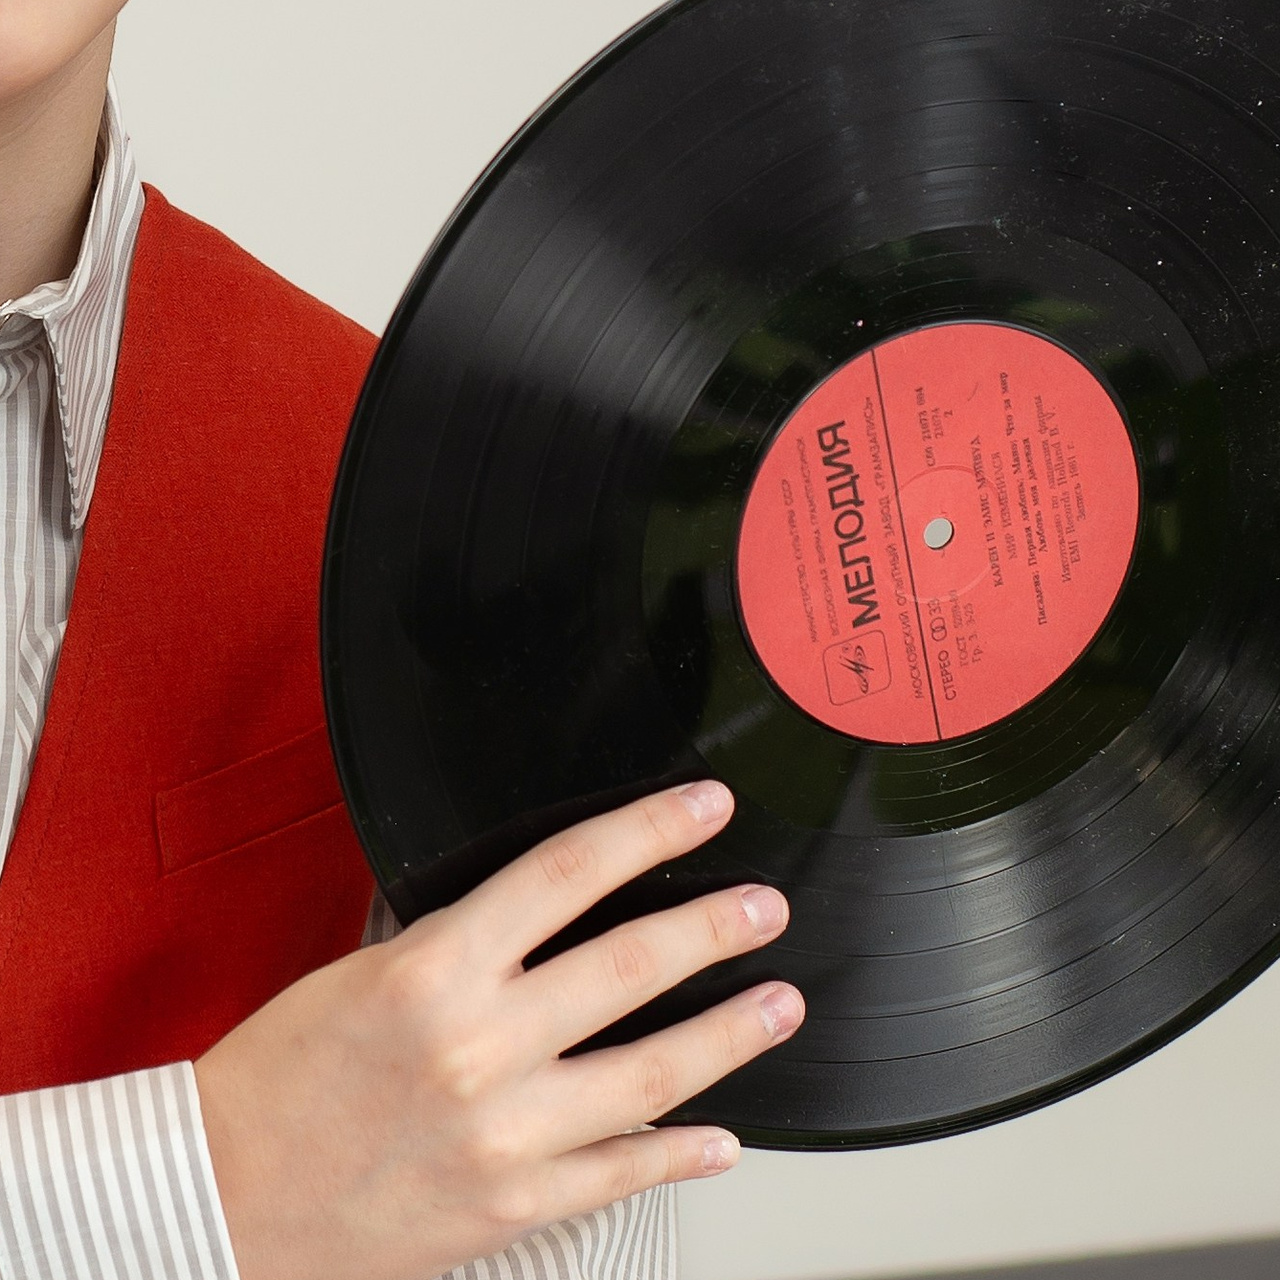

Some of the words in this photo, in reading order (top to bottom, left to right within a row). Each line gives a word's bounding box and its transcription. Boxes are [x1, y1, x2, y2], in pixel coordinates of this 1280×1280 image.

[942, 409, 954, 419] 2
[1005, 413, 1016, 438] Что
[1050, 440, 1069, 488] Holland
[979, 493, 993, 529] ЭЛИС
[990, 451, 1013, 529] ИЗМЕНИЛСЯ
[1029, 484, 1040, 507] моя
[1073, 481, 1087, 522] Запись
[815, 419, 882, 630] МЕЛОДИЯ
[877, 494, 896, 539] ЗАВОД
[1034, 509, 1049, 553] Любовь
[1059, 490, 1077, 536] Records
[984, 531, 996, 543] И
[1004, 531, 1019, 561] МИР
[1023, 525, 1039, 568] Первая
[1067, 539, 1082, 565] EMI
[884, 542, 908, 607] ОПЫТНЫЙ
[987, 545, 1004, 589] КАРЕН
[898, 610, 926, 700] МОСКОВСКИЙ
[954, 635, 970, 669] ГОСТ
[937, 649, 958, 702] СТЕРЕО
